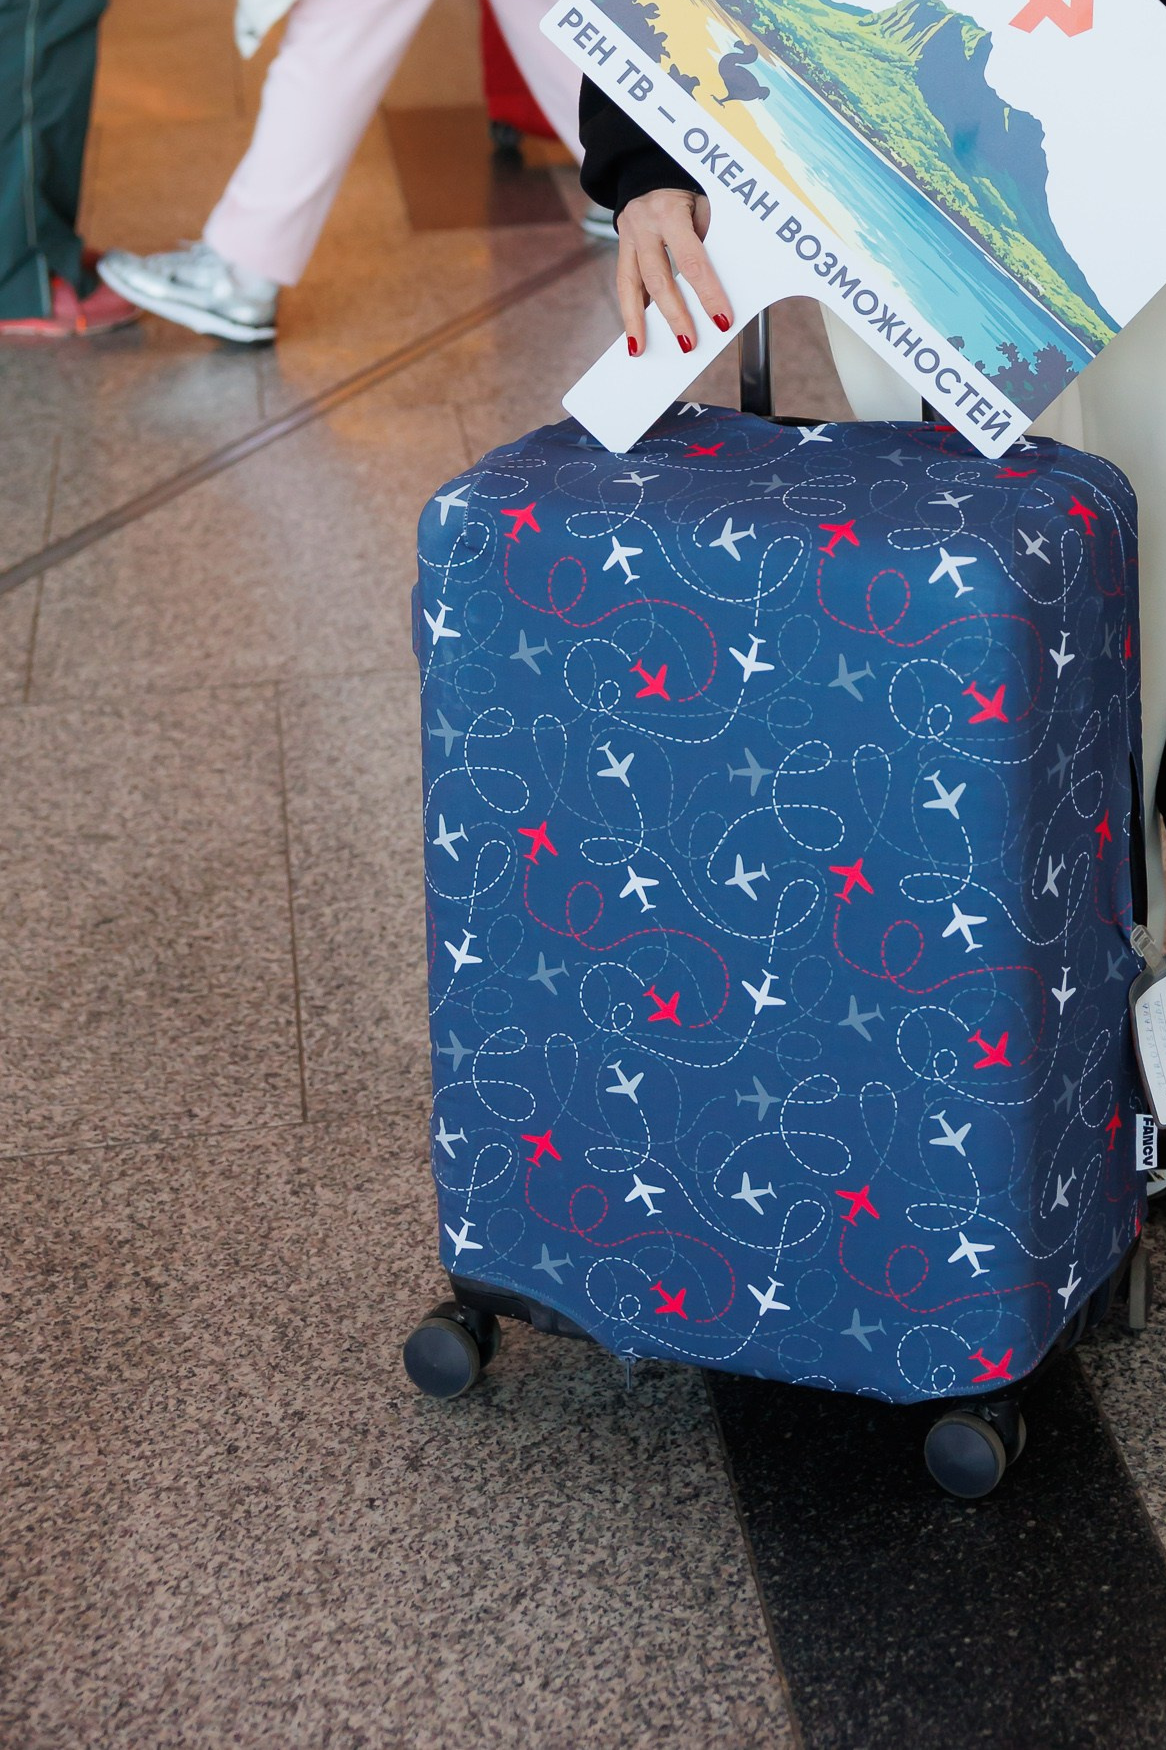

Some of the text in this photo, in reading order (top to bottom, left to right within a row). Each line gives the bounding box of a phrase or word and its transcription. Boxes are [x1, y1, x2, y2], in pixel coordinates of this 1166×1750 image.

[557, 7, 617, 66] РЕН
[616, 59, 654, 102] ТВ
[683, 127, 780, 222] ОКЕАН
[775, 215, 1013, 442] ВОЗМОЖНОСТЕЙ
